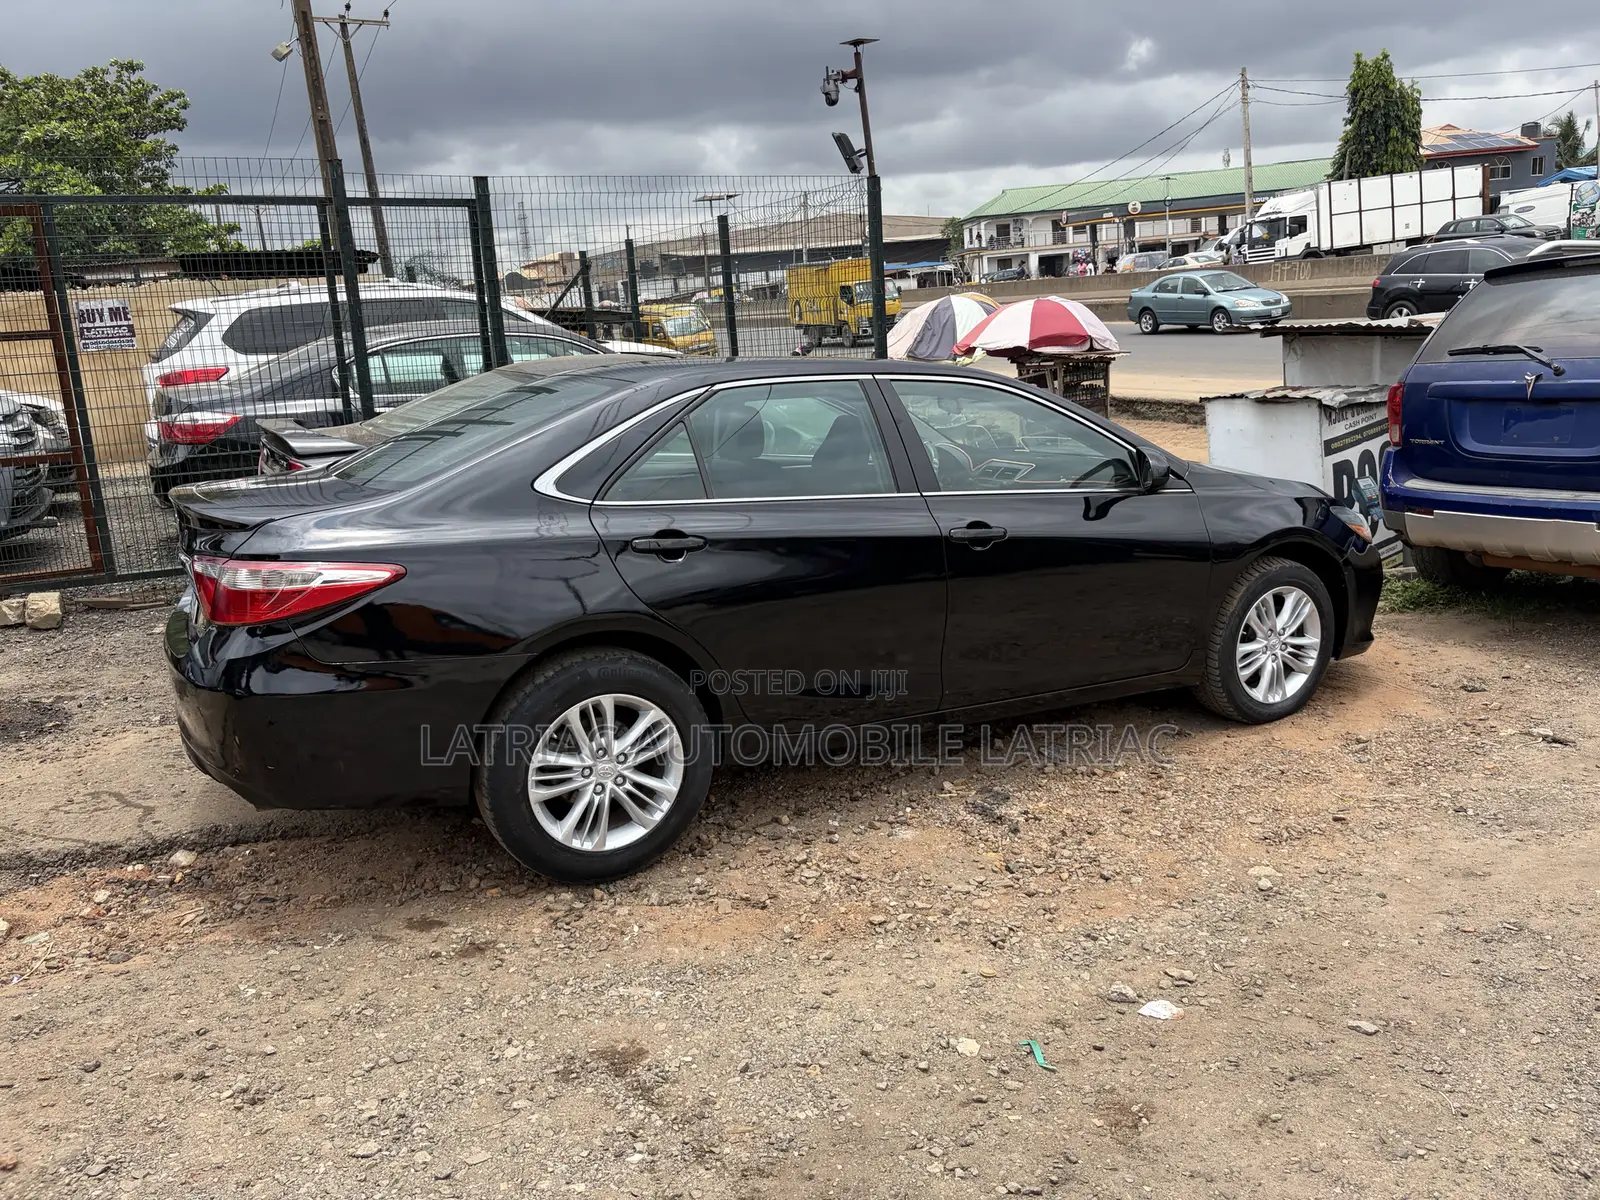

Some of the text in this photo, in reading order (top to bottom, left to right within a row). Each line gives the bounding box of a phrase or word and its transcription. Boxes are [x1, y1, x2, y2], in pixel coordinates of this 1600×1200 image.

[79, 306, 131, 323] BUY ME
[1344, 413, 1378, 431] CASH POINT
[1332, 440, 1391, 540] PO
